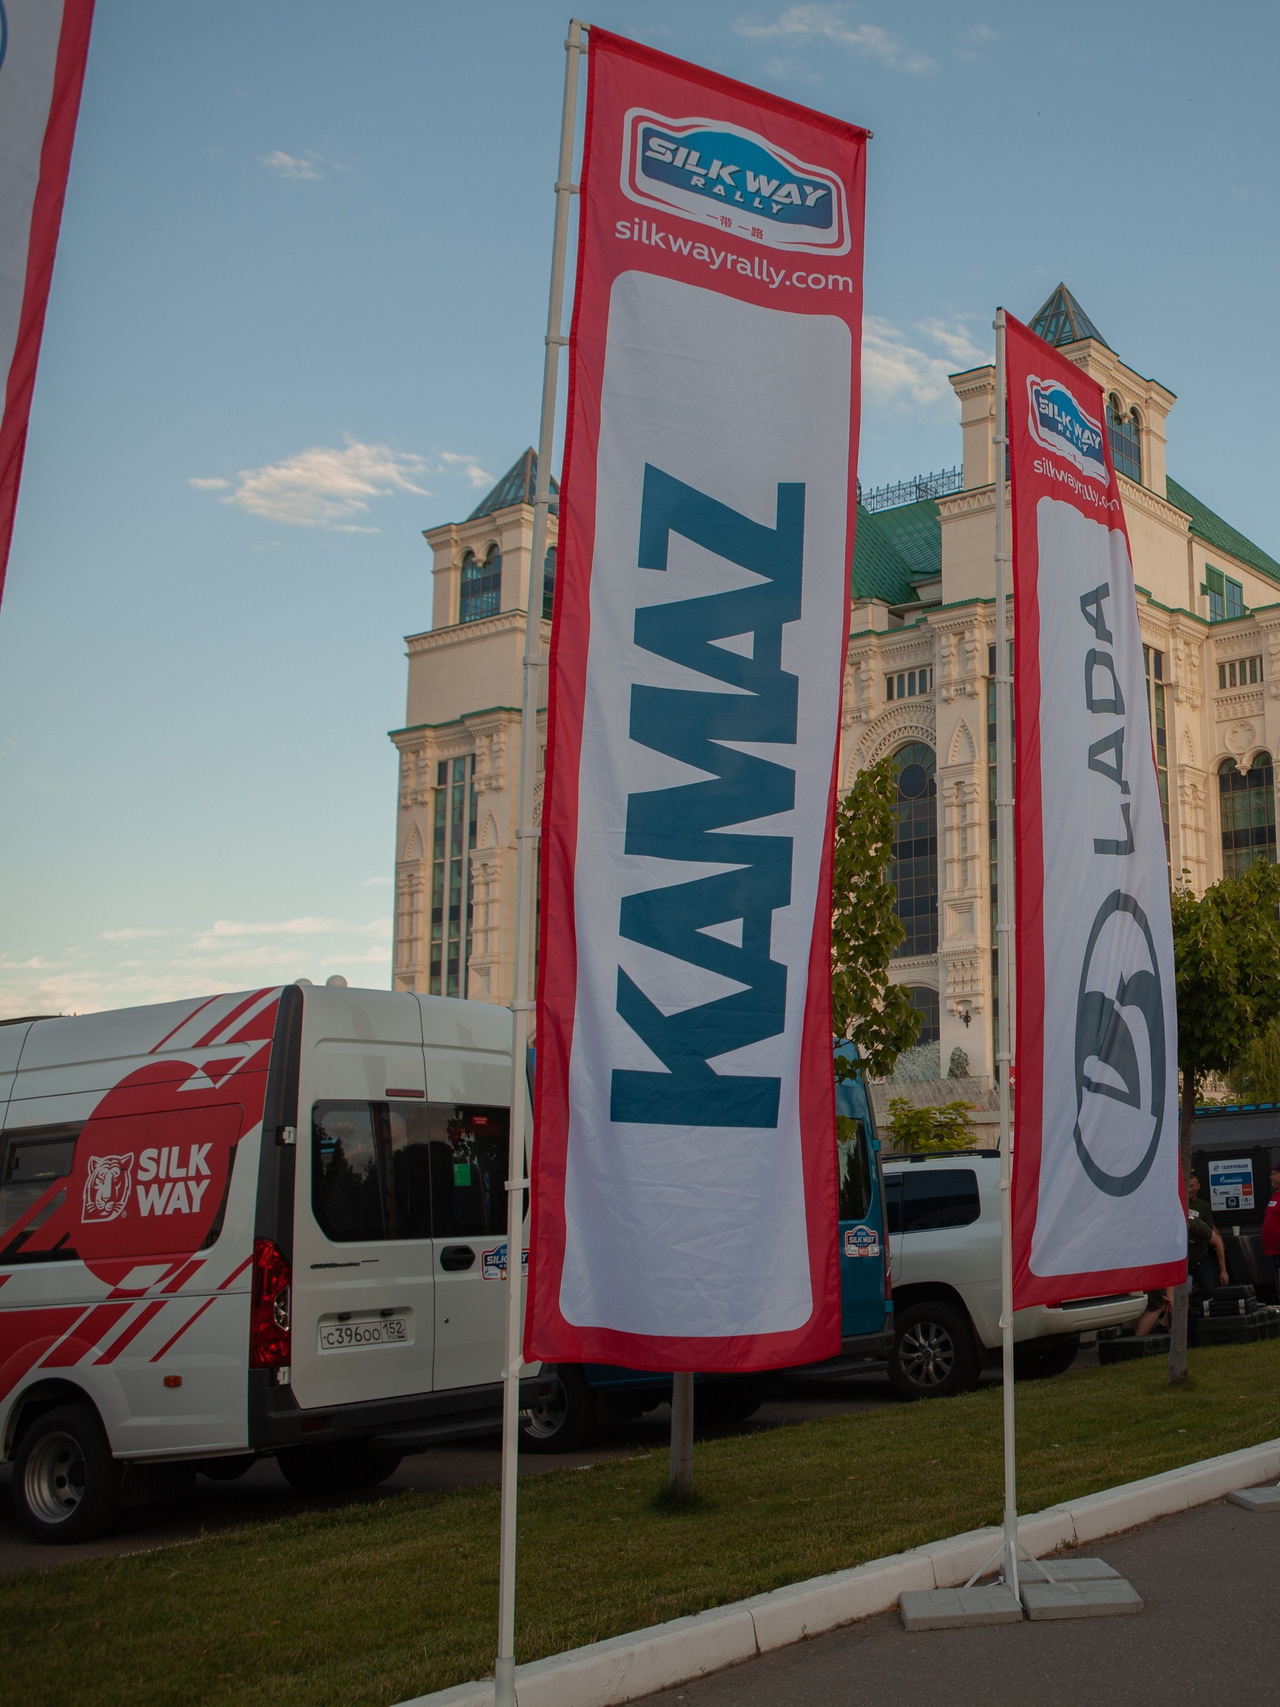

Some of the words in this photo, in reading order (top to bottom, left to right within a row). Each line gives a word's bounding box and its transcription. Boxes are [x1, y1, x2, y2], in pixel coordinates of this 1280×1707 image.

[645, 137, 740, 187] SILK
[746, 170, 829, 208] WAY
[690, 175, 784, 215] RALLY
[615, 217, 853, 293] silkwayrally.com
[1038, 397, 1073, 430] SILK
[1073, 420, 1102, 450] WAY
[1058, 424, 1090, 452] RALLY
[1080, 581, 1135, 856] LADA
[610, 462, 806, 1129] KAMAZ
[137, 1143, 214, 1182] SILK
[136, 1179, 211, 1217] WAY
[383, 1321, 403, 1335] 152
